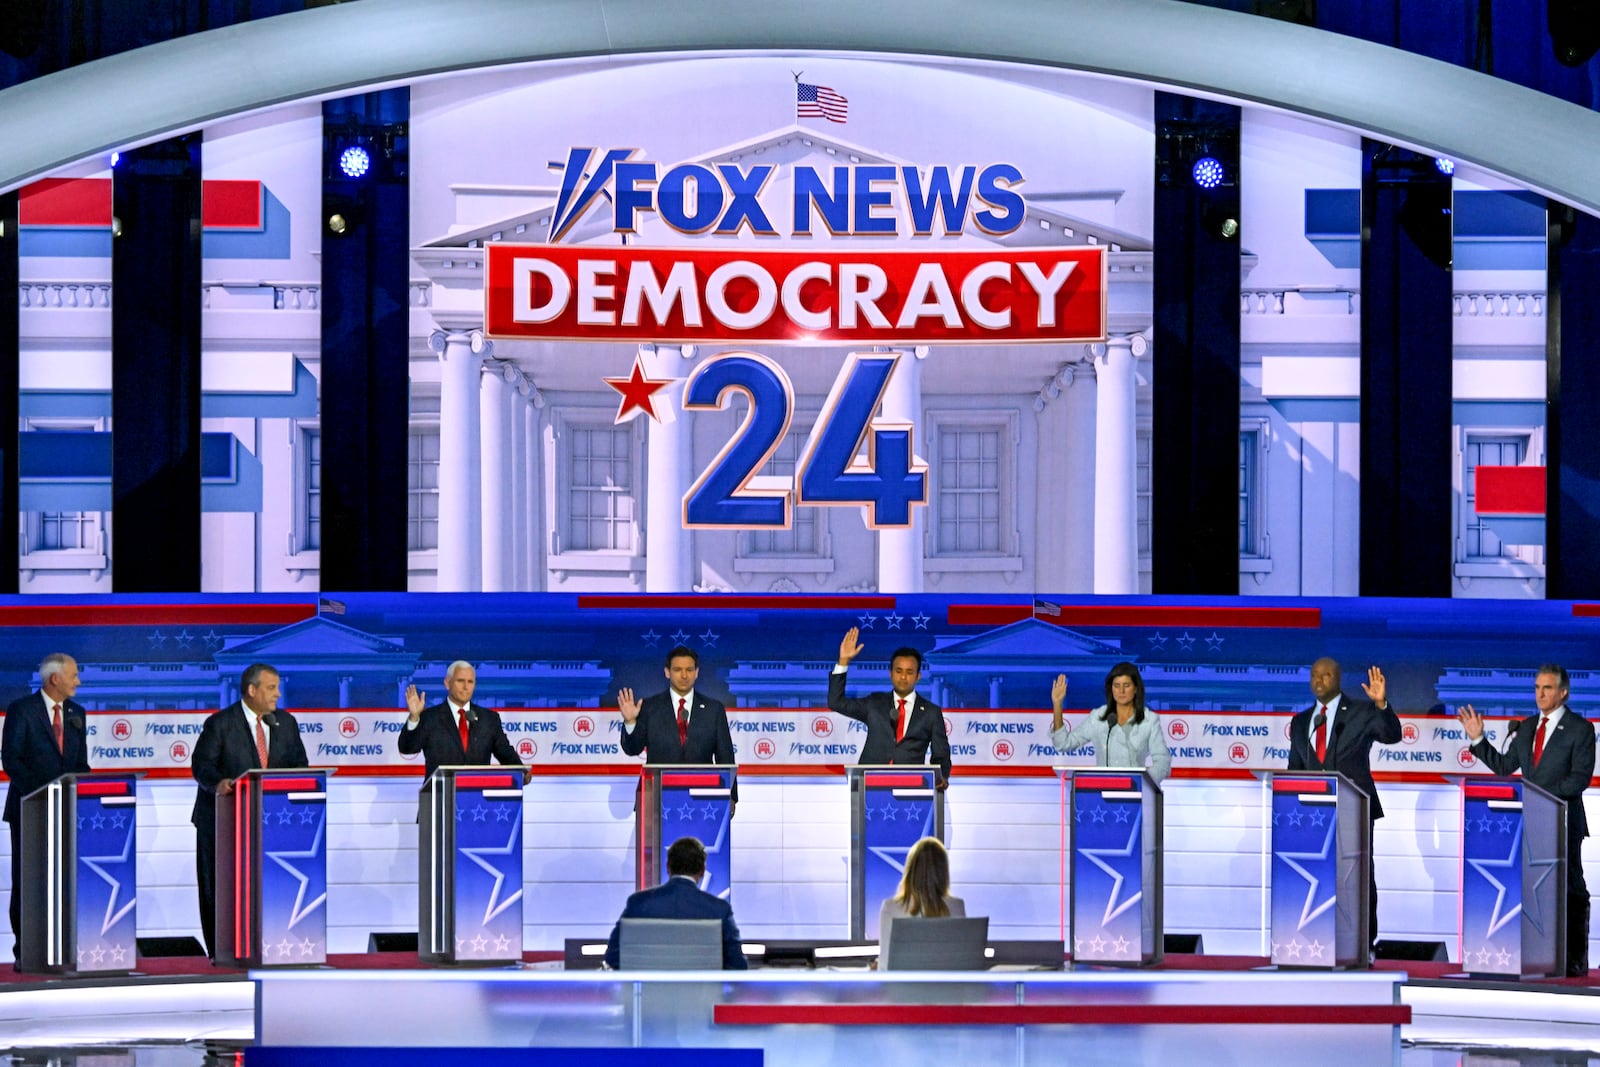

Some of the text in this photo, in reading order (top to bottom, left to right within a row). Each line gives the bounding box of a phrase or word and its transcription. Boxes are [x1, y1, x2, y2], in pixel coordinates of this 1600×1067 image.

[612, 160, 1028, 237] FOX NEWS
[511, 256, 1079, 331] DEMOCRACY
[681, 350, 929, 530] 24
[153, 723, 203, 735] FOX NEW
[298, 722, 323, 734] EWS
[524, 721, 557, 733] NEWS
[736, 721, 796, 733] FOX NEWS
[975, 722, 1034, 734] FOX NEWS
[1211, 725, 1269, 737] FOX NEWS
[1440, 729, 1462, 741] FOX
[100, 746, 155, 758] FOX NEWS
[326, 744, 383, 756] FOX NEWS
[560, 743, 618, 755] FOX NEWS
[799, 744, 857, 755] FOX NEWS
[951, 744, 977, 756] EWS
[1179, 747, 1213, 759] NEWS
[1386, 750, 1443, 762] FOX NEWS
